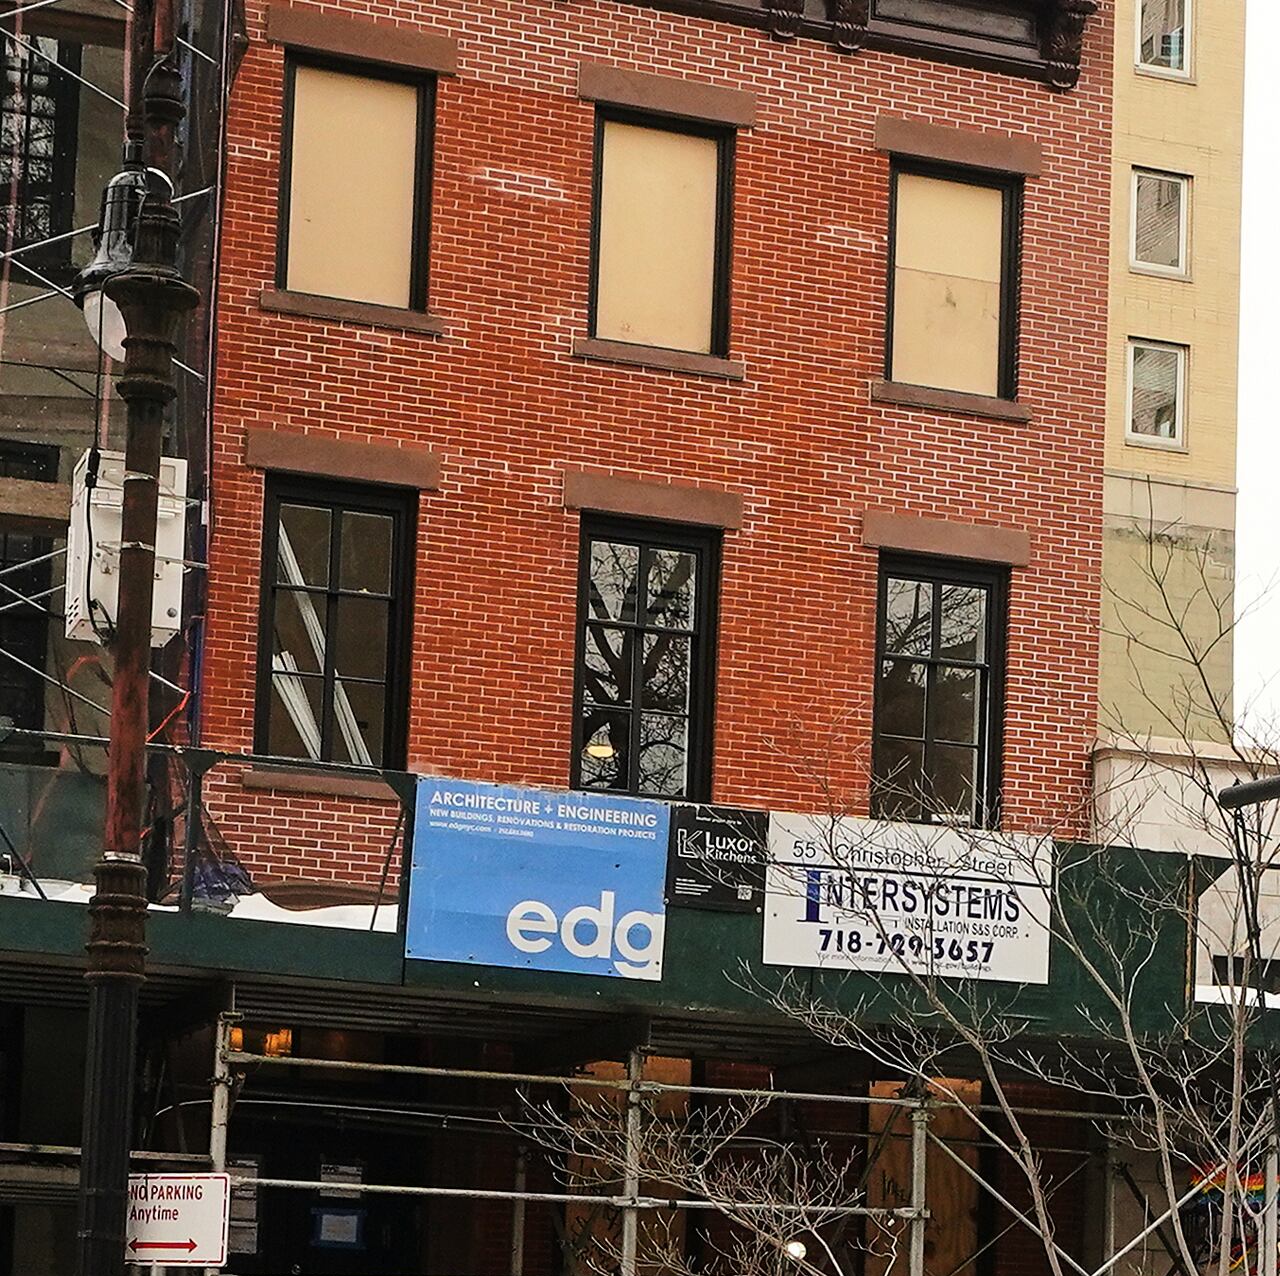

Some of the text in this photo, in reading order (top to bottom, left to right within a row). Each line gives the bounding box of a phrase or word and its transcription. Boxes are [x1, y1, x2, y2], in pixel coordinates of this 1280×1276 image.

[429, 808, 449, 818] NEW
[497, 815, 554, 830] RENOVATIONS
[563, 822, 616, 836] RESTORATION
[618, 829, 656, 840] PROJECTS
[430, 791, 539, 815] ARCHITECTURE
[557, 804, 658, 828] ENGINEERING
[705, 831, 753, 852] Luxor
[705, 847, 757, 864] Kitchens
[792, 839, 817, 859] 55
[836, 842, 943, 868] Christopher
[797, 868, 1020, 924] INTERSYSTEMS
[506, 890, 666, 981] edg
[904, 915, 1020, 940] INSTALLATION S&S CORP.
[818, 929, 995, 964] 718-729-3657
[130, 1184, 203, 1201] NO PARKING
[129, 1204, 179, 1225] Anytime
